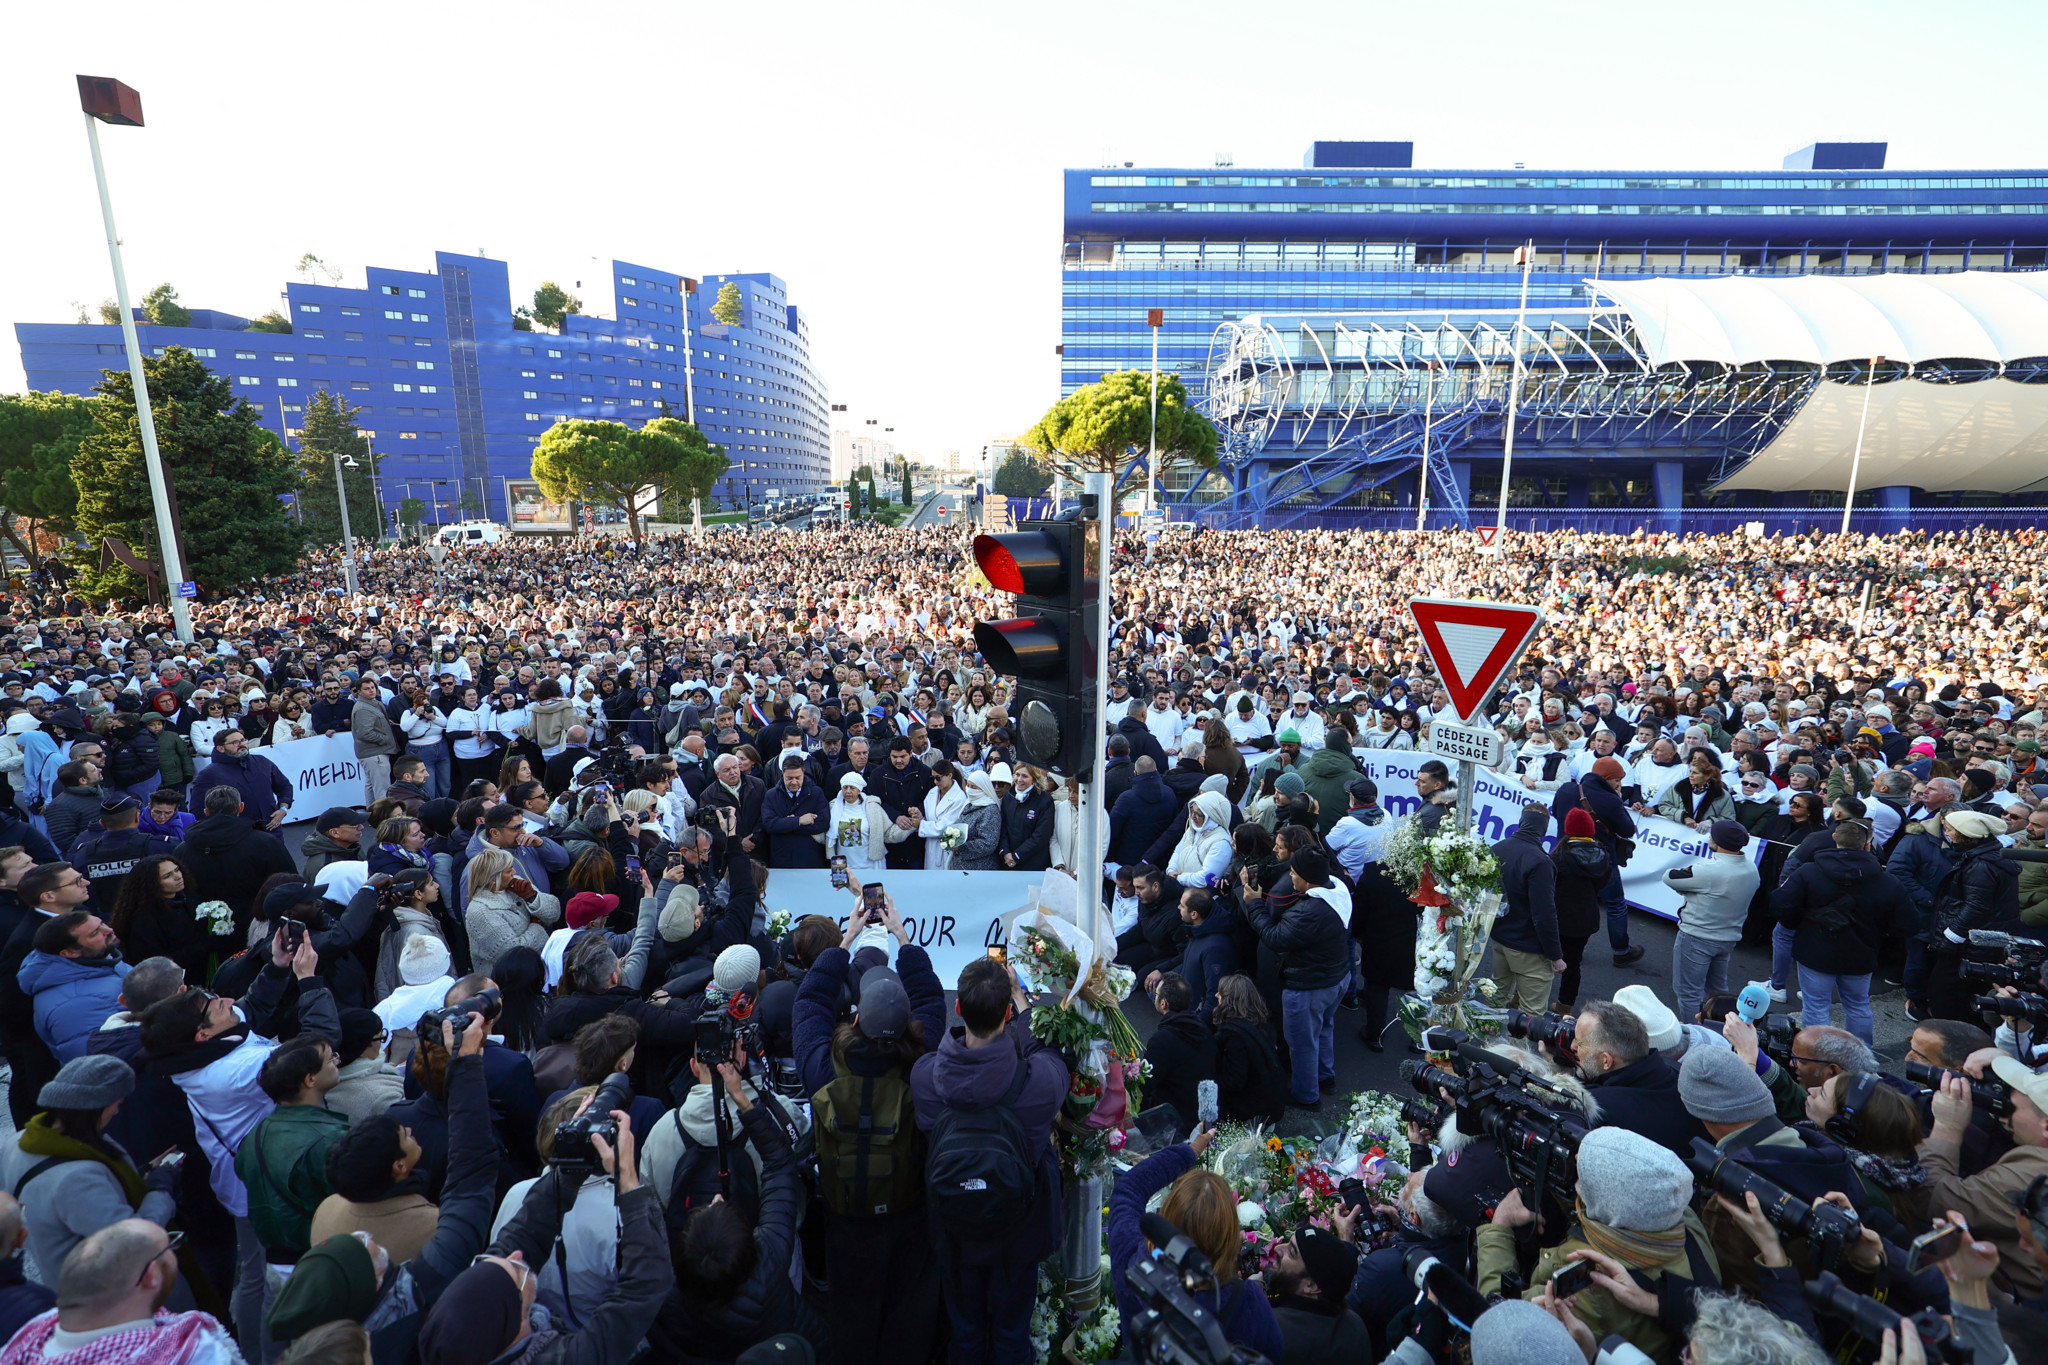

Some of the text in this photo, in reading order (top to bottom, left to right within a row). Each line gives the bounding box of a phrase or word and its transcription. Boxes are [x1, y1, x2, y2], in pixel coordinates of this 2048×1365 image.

[1437, 727, 1490, 748] CÉDEZ LE
[1436, 741, 1489, 761] PASSAGE
[299, 761, 361, 791] MEHDI
[1385, 765, 1419, 780] Pou
[89, 869, 131, 878] NATIONA
[889, 915, 956, 947] OUR
[1744, 996, 1758, 1009] ici
